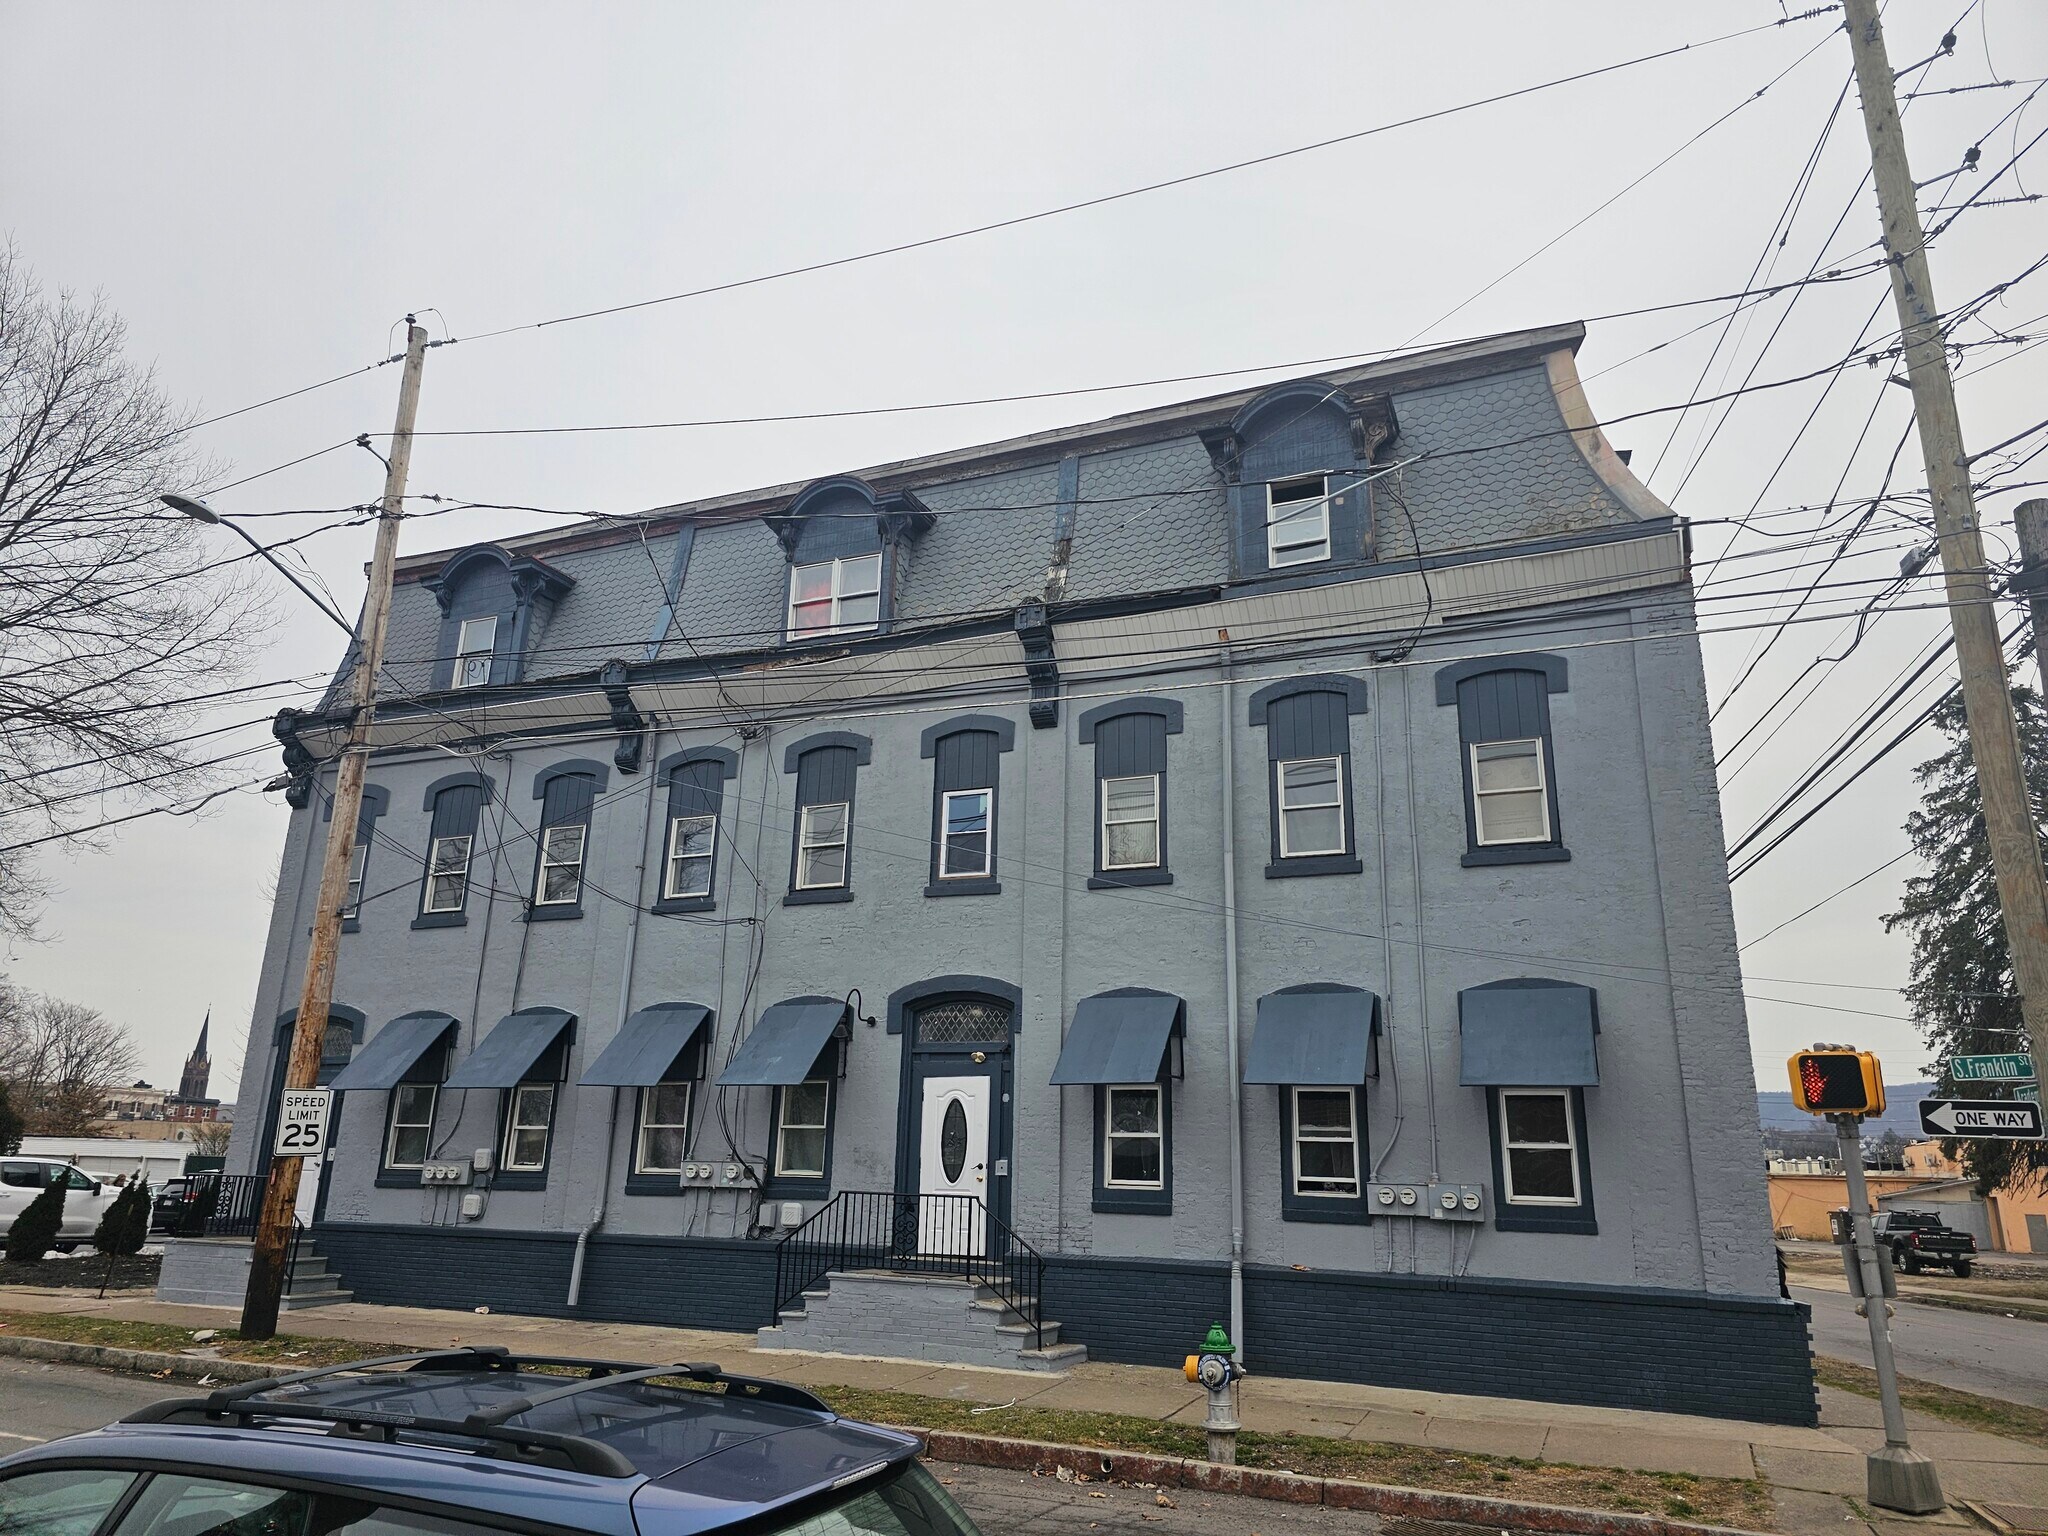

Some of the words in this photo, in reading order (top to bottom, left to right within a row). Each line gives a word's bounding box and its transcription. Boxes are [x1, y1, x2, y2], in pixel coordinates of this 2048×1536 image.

[2018, 1055, 2029, 1066] St
[286, 1097, 326, 1107] SPEED
[288, 1110, 320, 1121] LIMIT
[1955, 1112, 1988, 1126] ONE
[1993, 1112, 2026, 1127] WAY
[282, 1124, 319, 1147] 25
